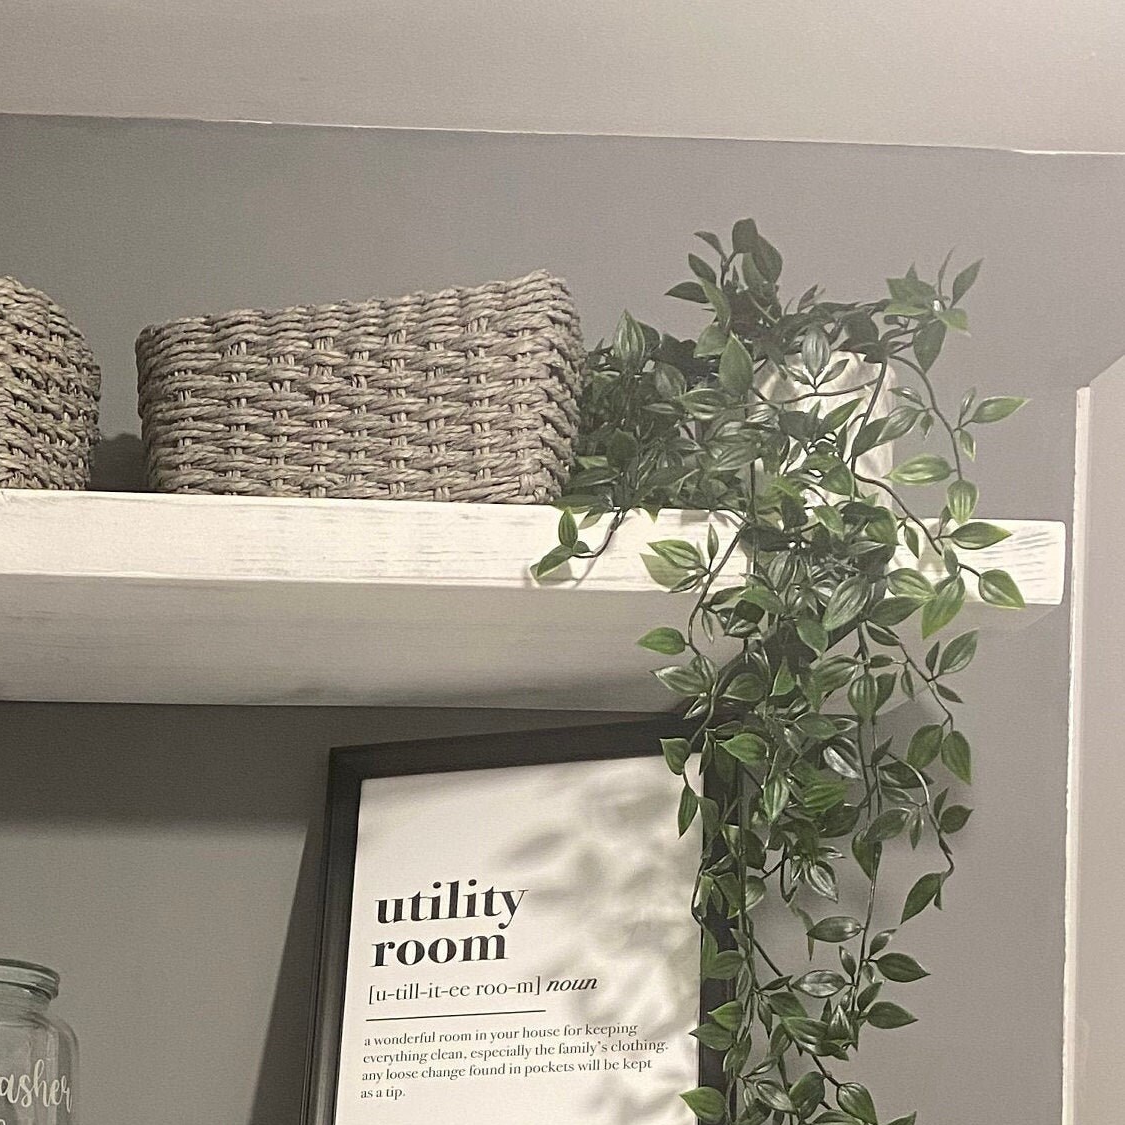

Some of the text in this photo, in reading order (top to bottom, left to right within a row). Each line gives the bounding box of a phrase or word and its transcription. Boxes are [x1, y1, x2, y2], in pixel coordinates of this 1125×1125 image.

[375, 879, 528, 929] utility
[370, 934, 508, 968] room
[368, 976, 597, 1005] [u-till-it-ee roo-m] noun
[364, 1023, 638, 1046] a wonderful room in your house for keeping
[363, 1049, 427, 1065] everything
[431, 1048, 467, 1061] clean,
[470, 1042, 531, 1059] especially
[535, 1042, 555, 1056] the
[558, 1040, 608, 1055] family's
[362, 1058, 652, 1083] any loose change found in pockets will be kept
[360, 1086, 406, 1102] as a tip.
